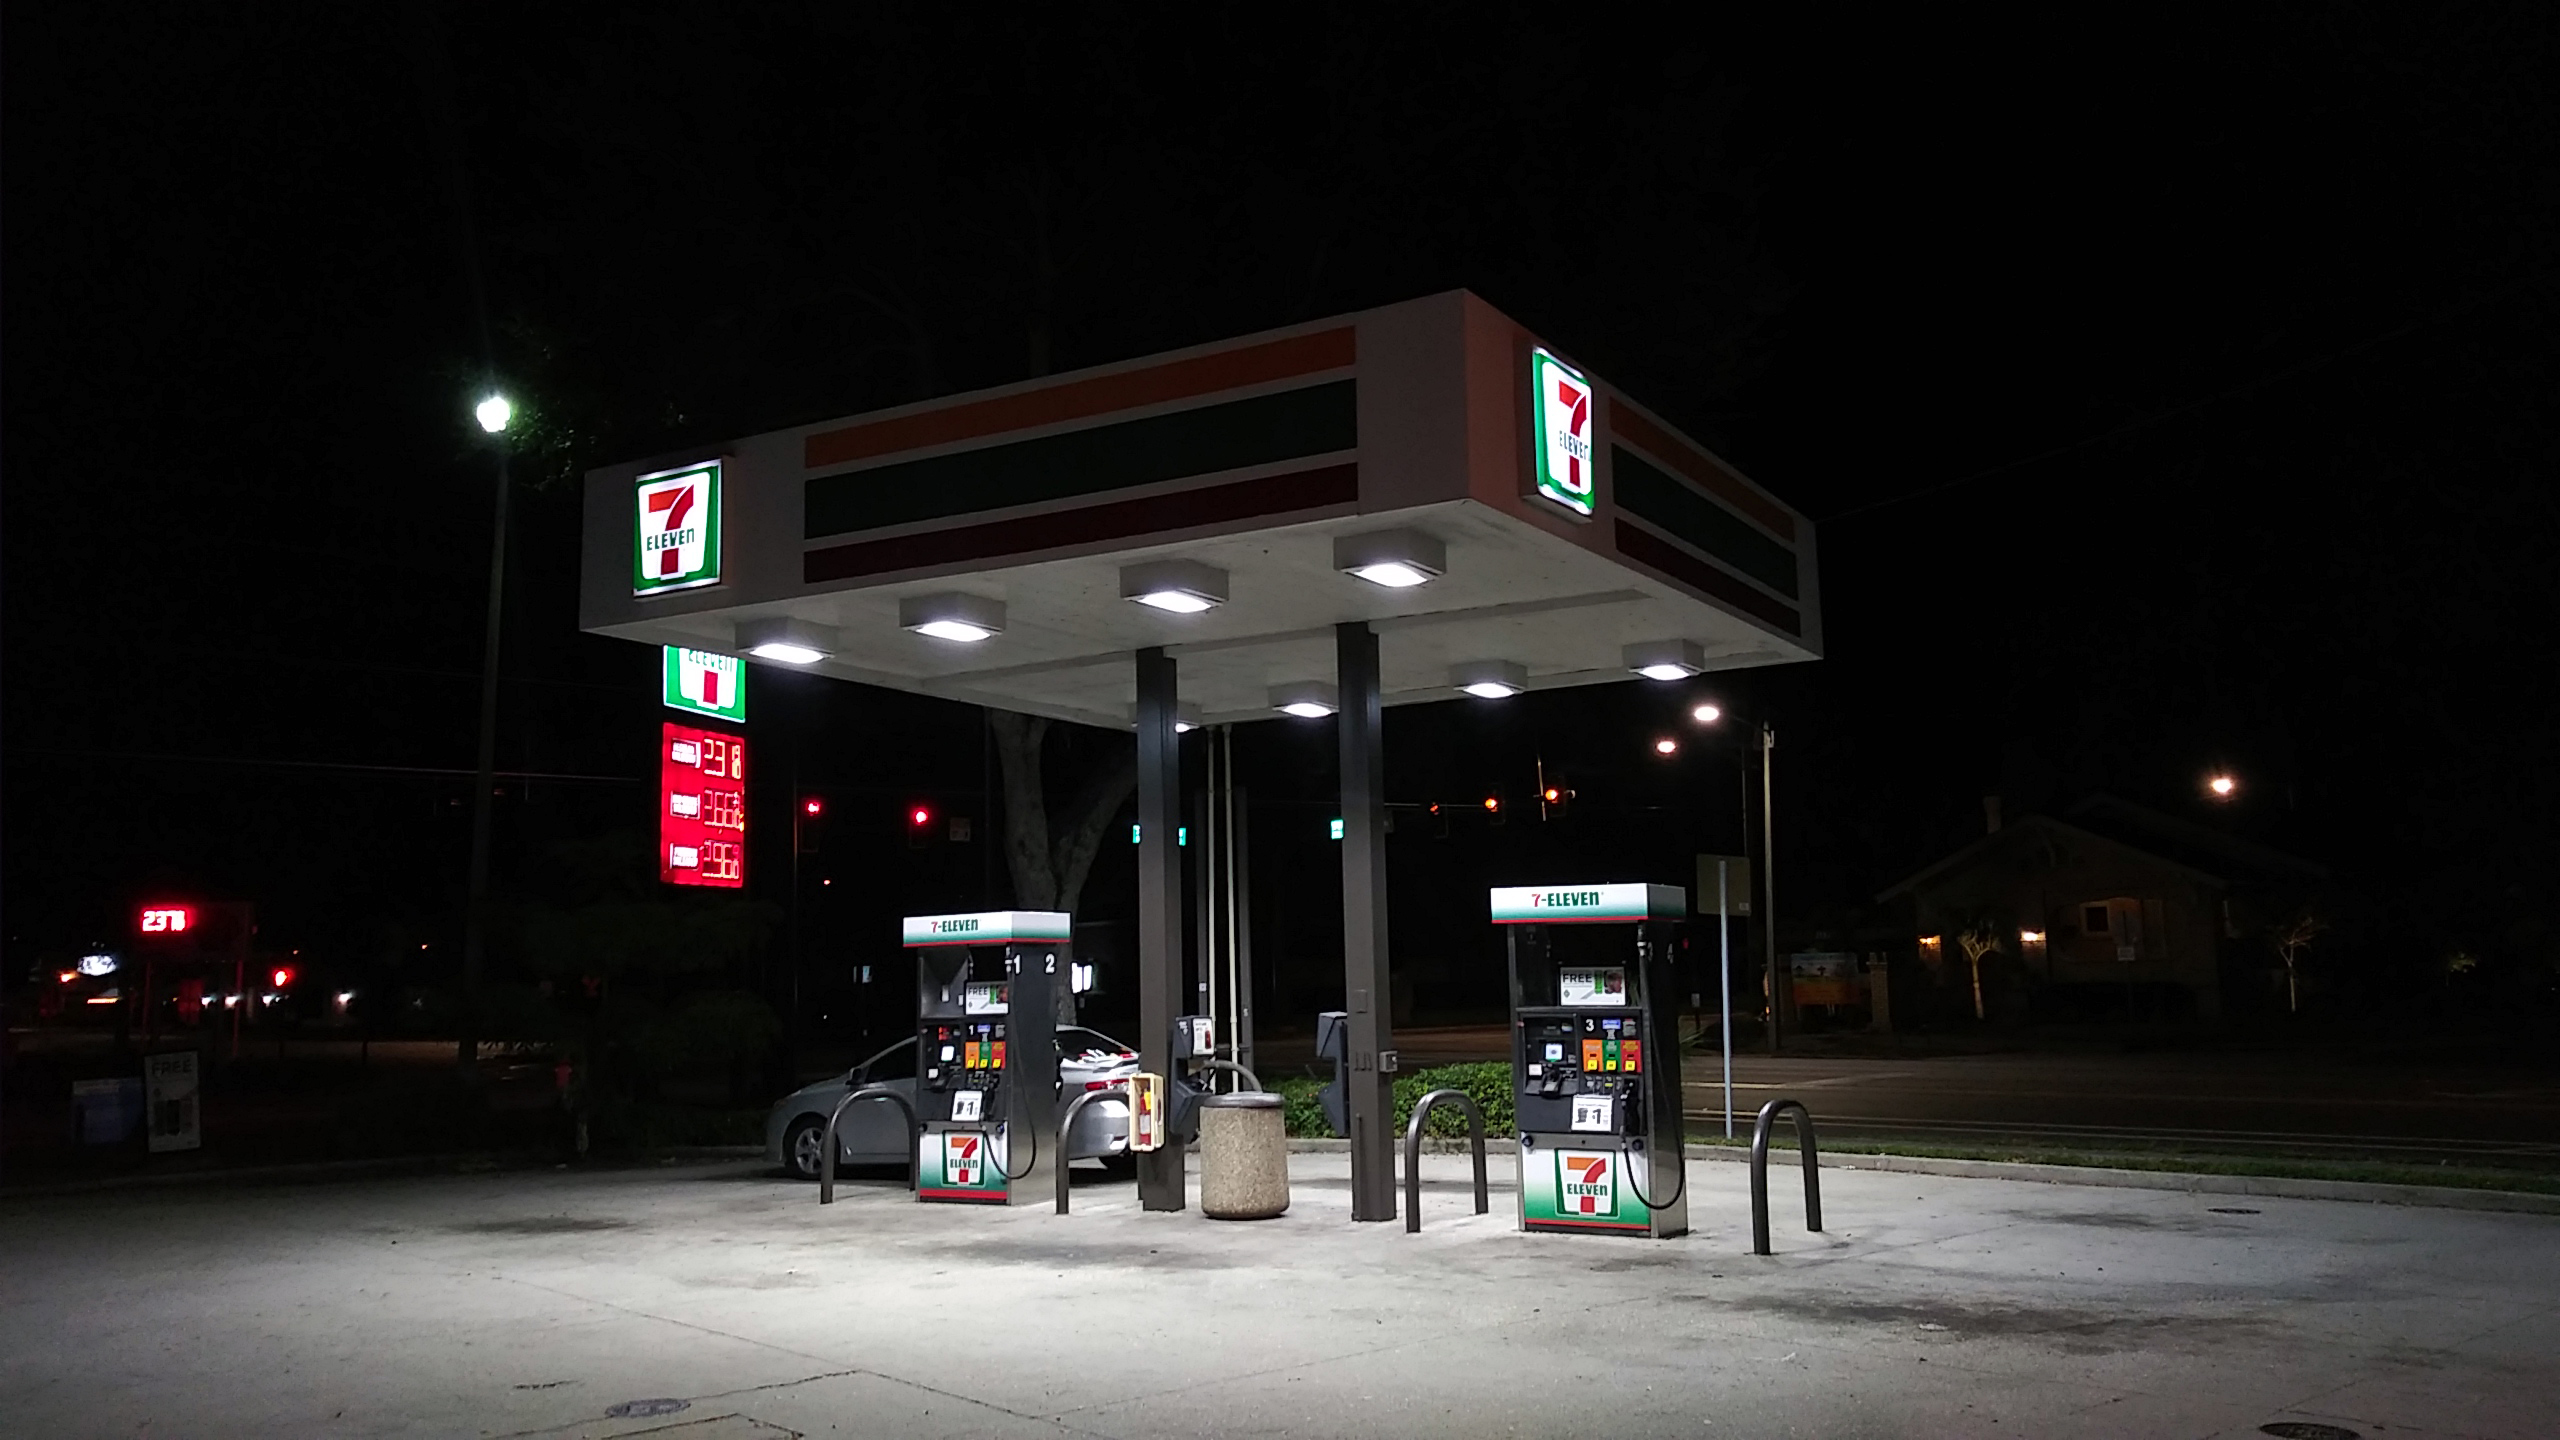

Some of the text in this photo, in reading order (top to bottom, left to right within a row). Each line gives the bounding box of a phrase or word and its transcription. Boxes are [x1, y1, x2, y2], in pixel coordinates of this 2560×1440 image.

[1013, 954, 1022, 975] 1
[1045, 953, 1056, 974] 2
[1562, 973, 1593, 984] FREE
[967, 986, 989, 996] FREE
[968, 1024, 974, 1036] 1
[1585, 1018, 1595, 1032] 3
[152, 1059, 193, 1076] FREE
